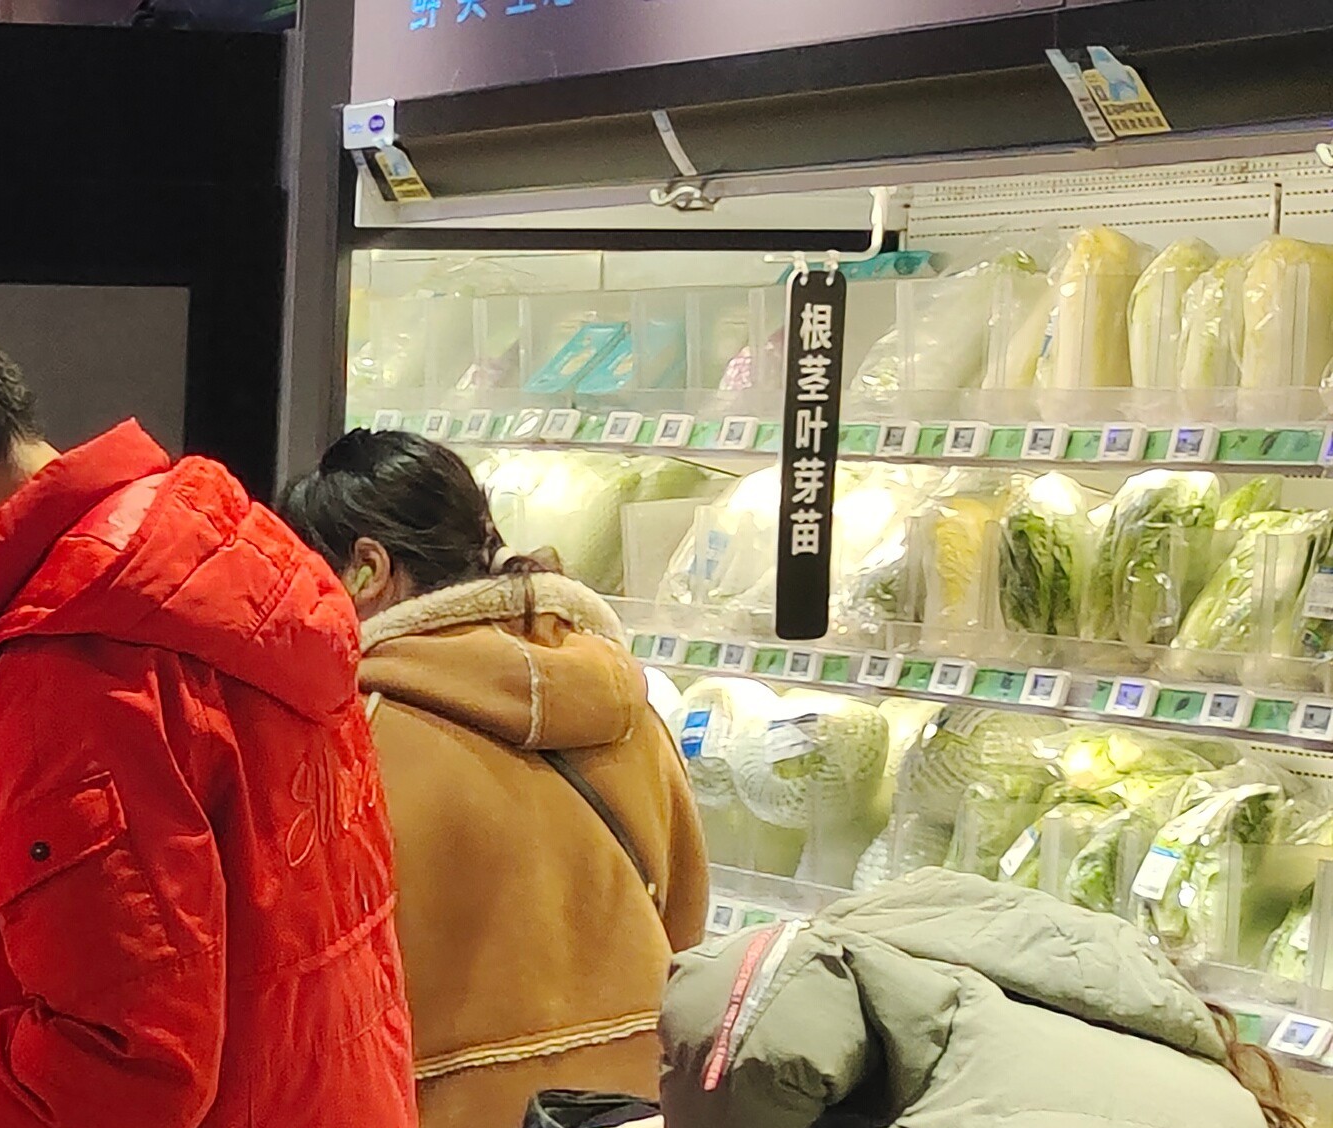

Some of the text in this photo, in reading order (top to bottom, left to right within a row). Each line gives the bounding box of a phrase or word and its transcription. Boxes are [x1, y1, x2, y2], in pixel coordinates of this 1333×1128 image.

[790, 302, 833, 556] 根茎叶芽苗
